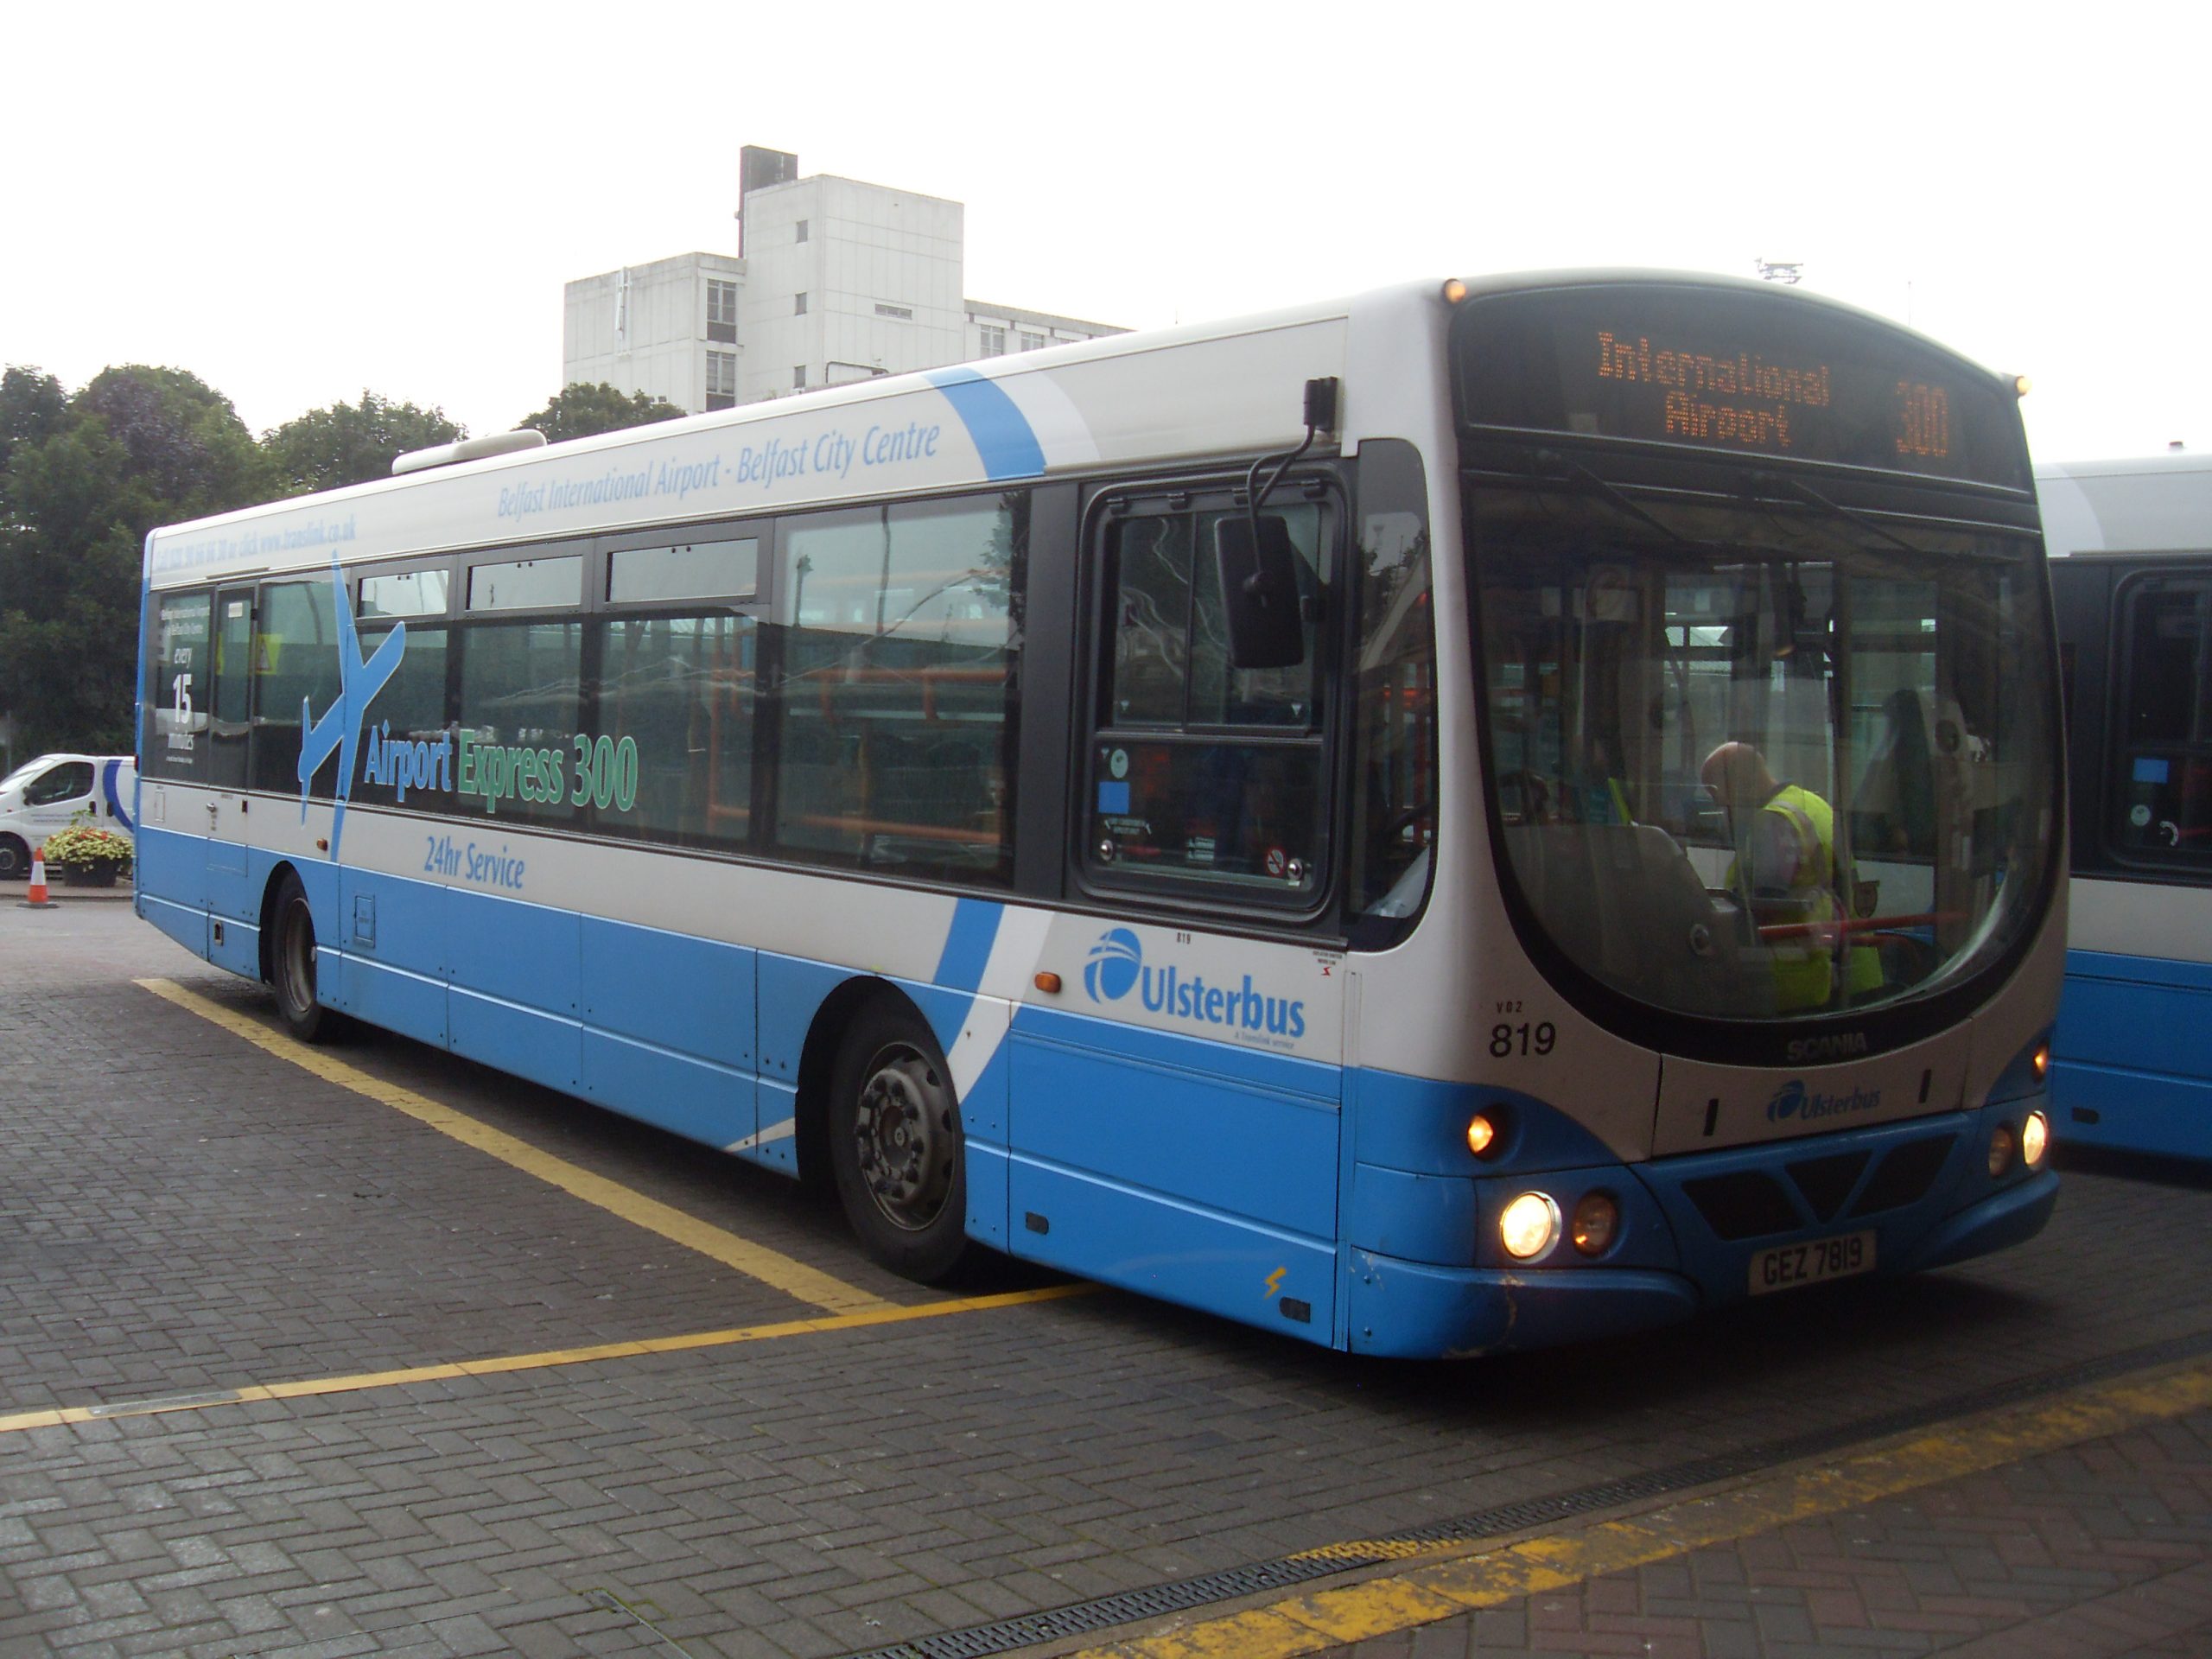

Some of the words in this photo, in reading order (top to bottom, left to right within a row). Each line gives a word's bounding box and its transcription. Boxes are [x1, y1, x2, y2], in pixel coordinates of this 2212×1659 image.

[1598, 332, 1830, 407] International
[1666, 390, 1791, 448] Airport
[498, 480, 546, 523] Belfast
[548, 460, 653, 511] International
[654, 455, 721, 501] Airport
[737, 437, 808, 489] Belfast
[813, 429, 856, 479] City
[863, 422, 940, 467] Centre
[173, 673, 193, 725] 15
[364, 718, 453, 804] Airport
[457, 728, 564, 814] Express
[570, 734, 639, 812] 300
[423, 836, 461, 878] 24hr
[465, 842, 525, 890] Service
[1177, 932, 1192, 944] 819
[1141, 965, 1306, 1039] Ulsterbus
[1489, 1021, 1556, 1058] 819
[1787, 1032, 1868, 1062] SCANIA
[1801, 1084, 1881, 1121] Ulsterbus
[1764, 1247, 1808, 1286] GEZ
[1814, 1236, 1862, 1275] 7819
